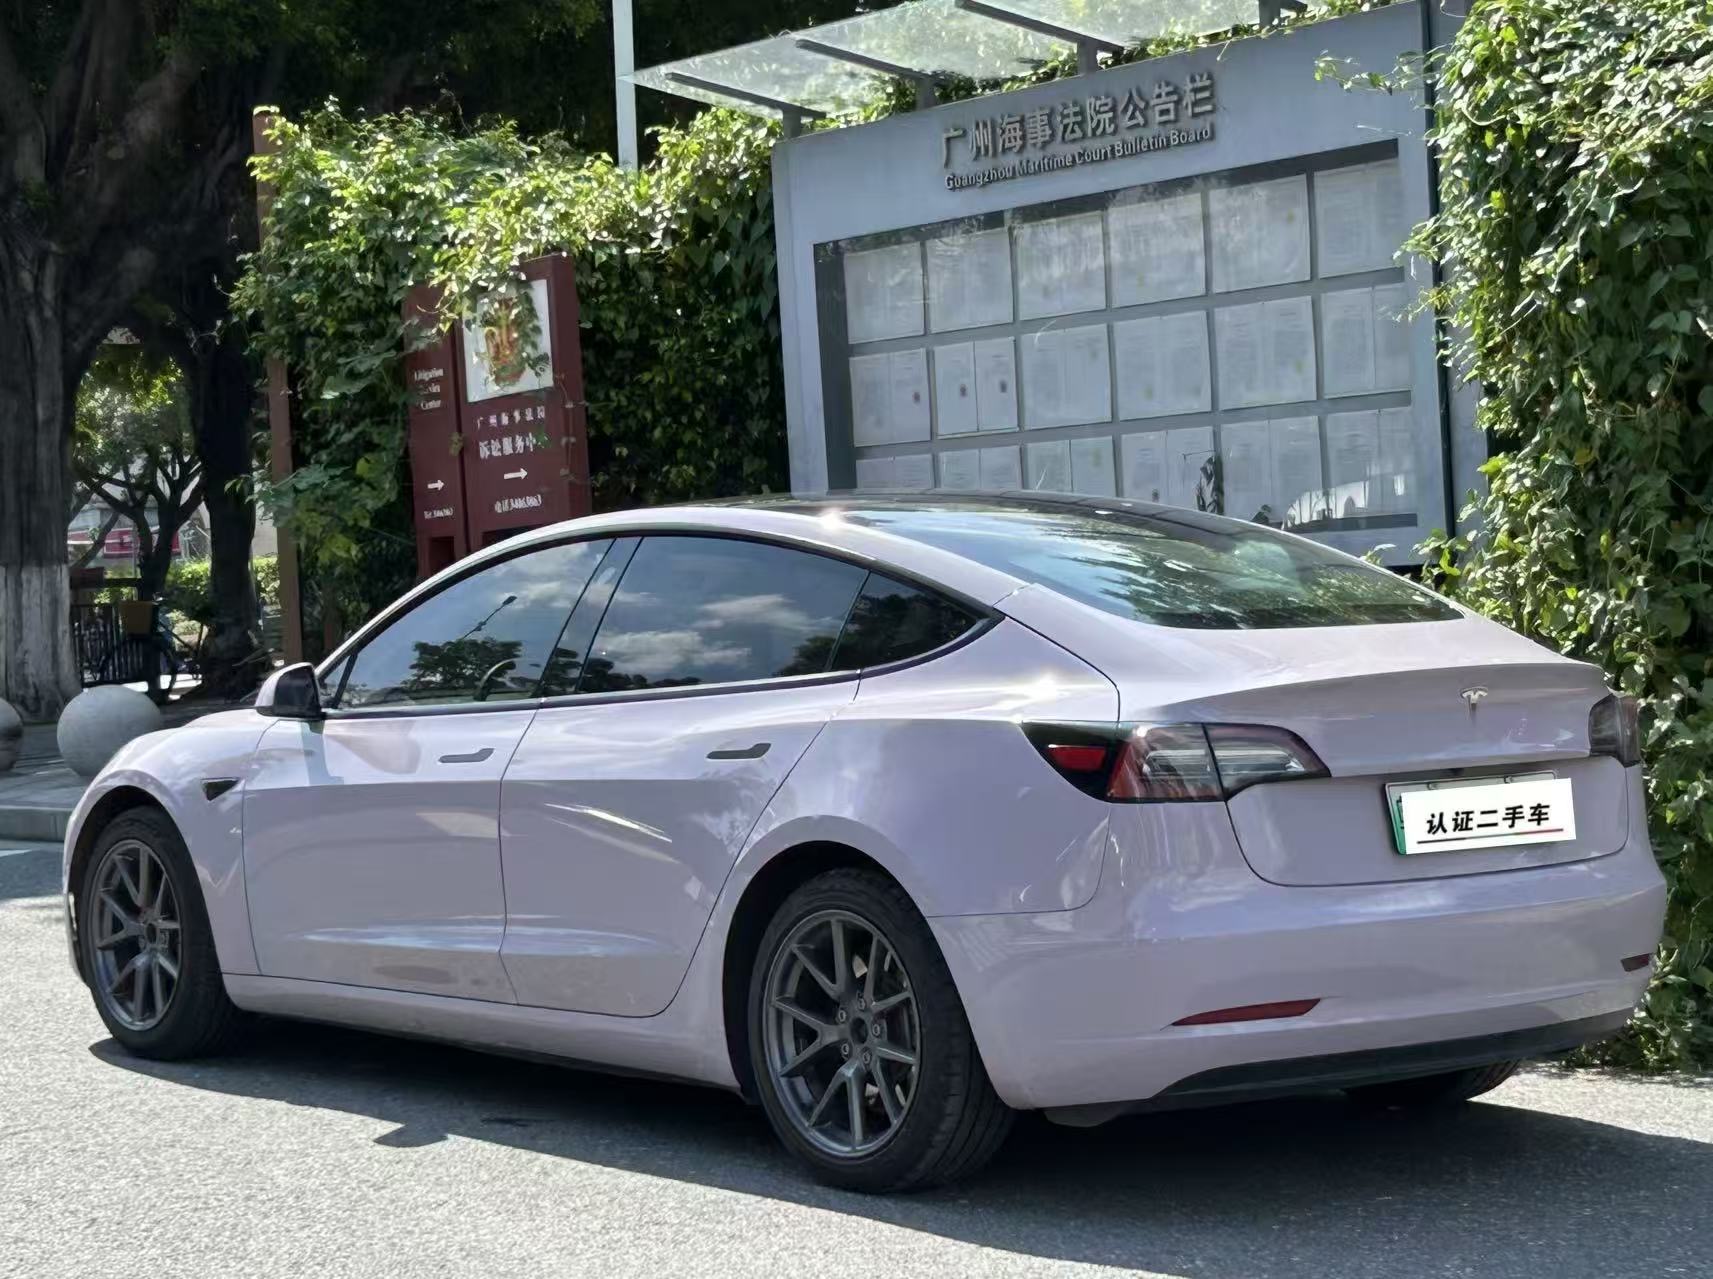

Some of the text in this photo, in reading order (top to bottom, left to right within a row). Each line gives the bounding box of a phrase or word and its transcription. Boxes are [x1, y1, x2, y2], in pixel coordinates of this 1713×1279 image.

[942, 72, 1216, 168] 广州海事法院公告栏
[944, 124, 1212, 190] Guangzhou Maritime Court Bulletin Board
